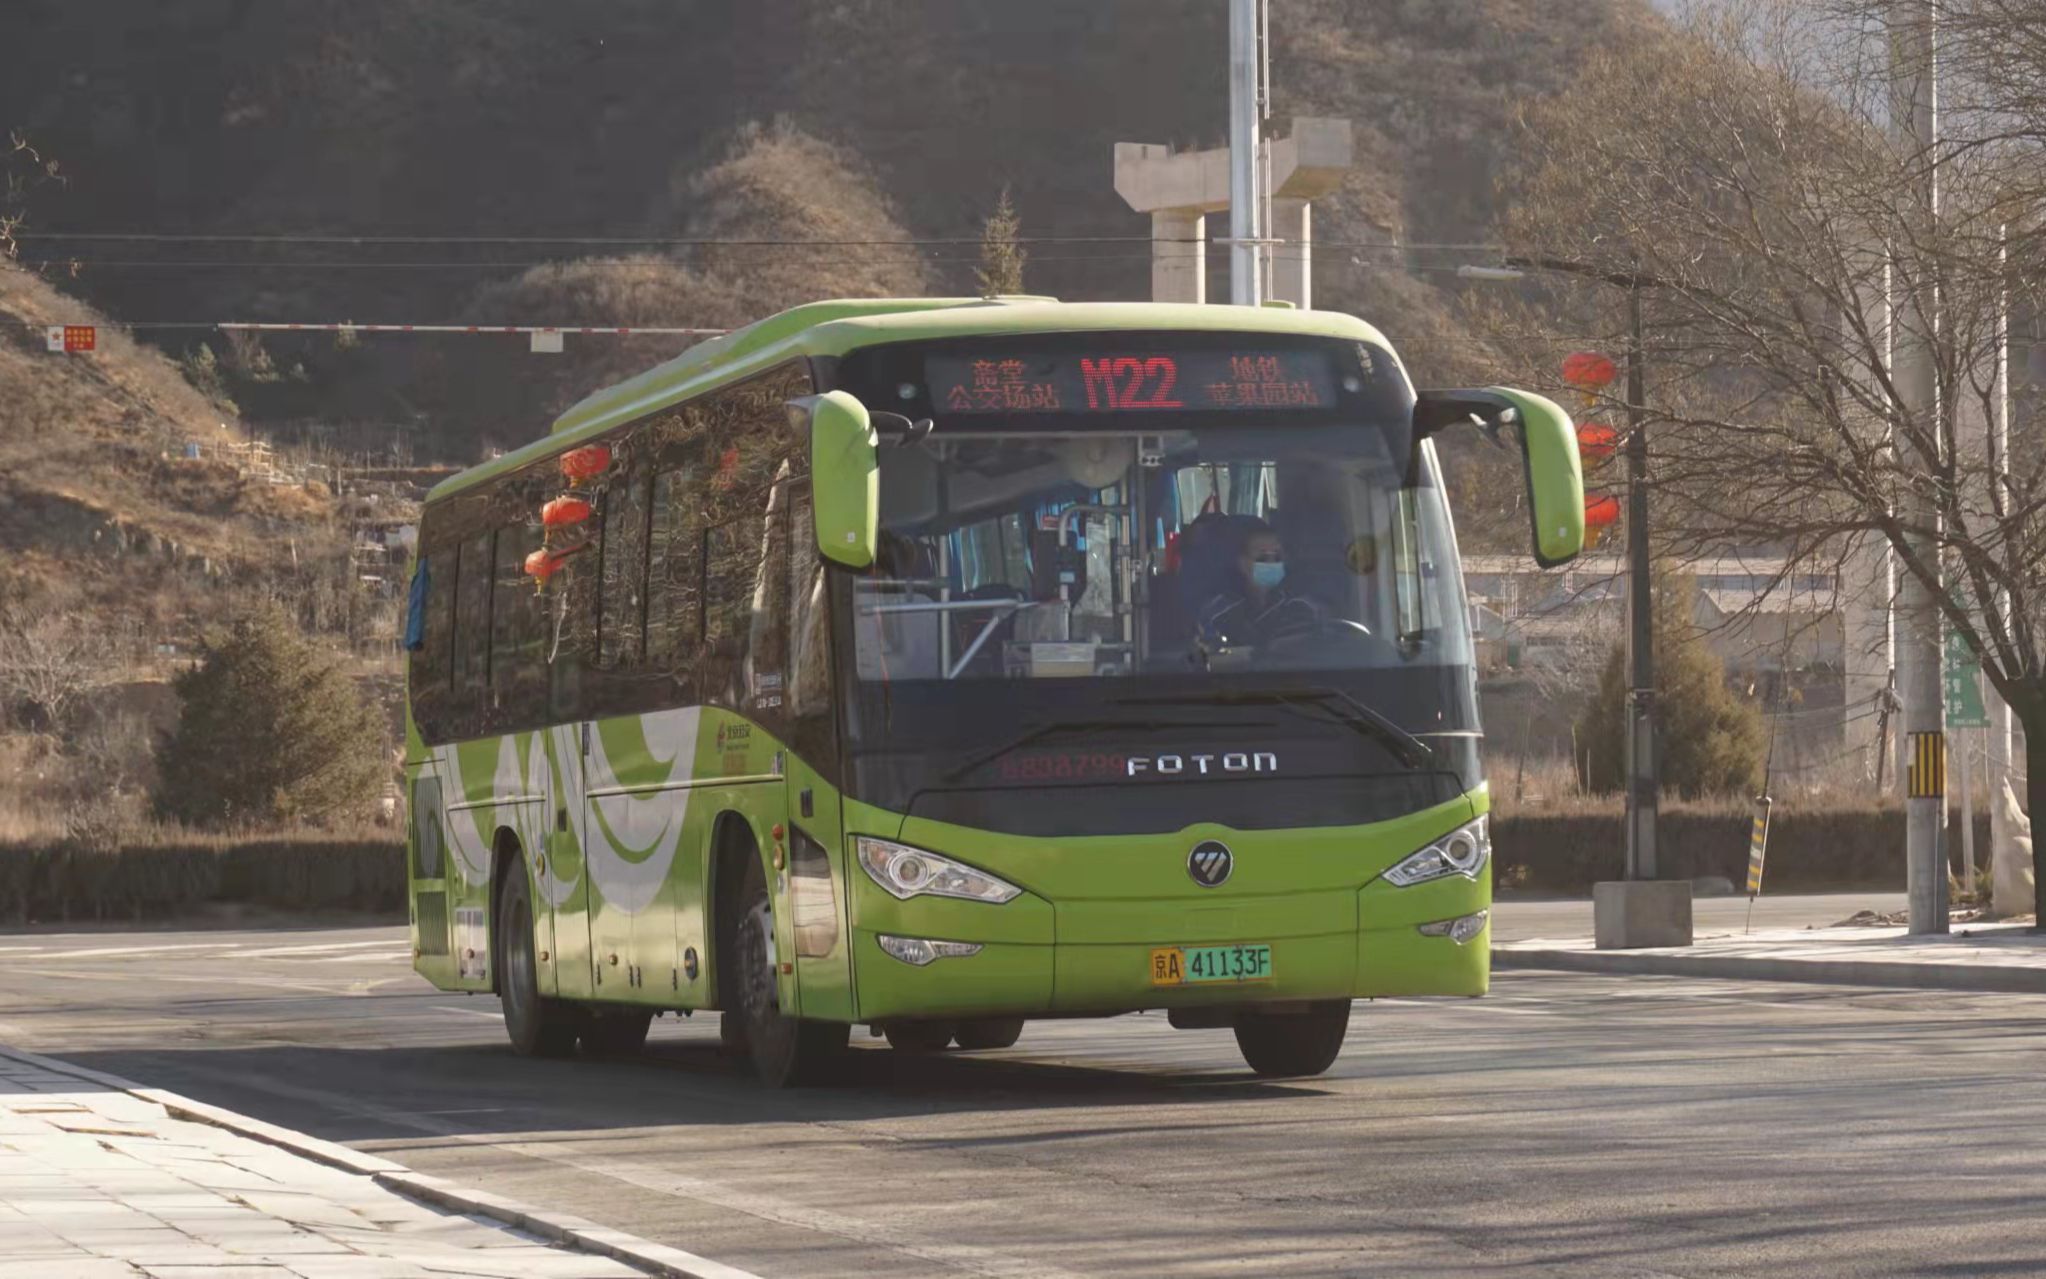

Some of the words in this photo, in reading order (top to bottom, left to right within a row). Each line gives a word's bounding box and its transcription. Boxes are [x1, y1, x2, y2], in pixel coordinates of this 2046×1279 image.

[1080, 357, 1184, 408] M22
[947, 384, 1060, 410] 公交场站
[1127, 752, 1277, 776] FOTON
